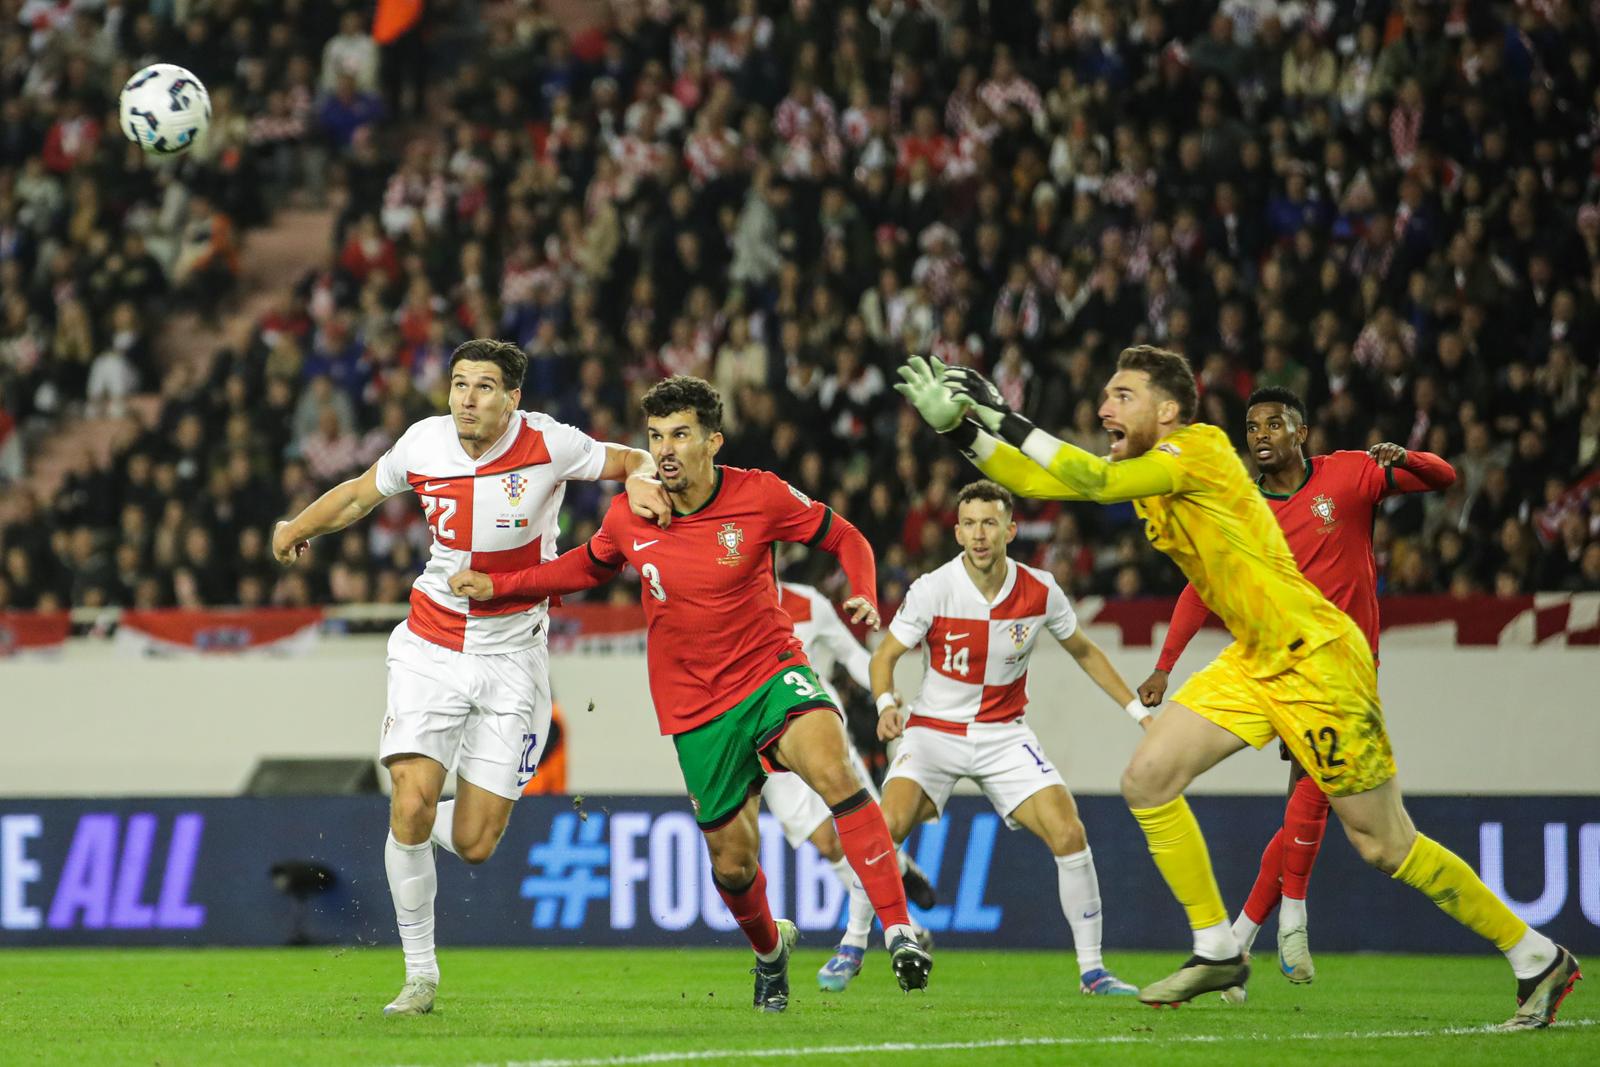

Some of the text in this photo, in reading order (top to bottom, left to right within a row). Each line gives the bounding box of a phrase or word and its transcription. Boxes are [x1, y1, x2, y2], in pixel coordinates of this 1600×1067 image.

[421, 495, 457, 540] 22
[641, 563, 667, 602] 3
[942, 644, 970, 676] 14
[783, 671, 817, 696] 3
[1304, 726, 1346, 768] 12
[48, 812, 206, 929] ALL
